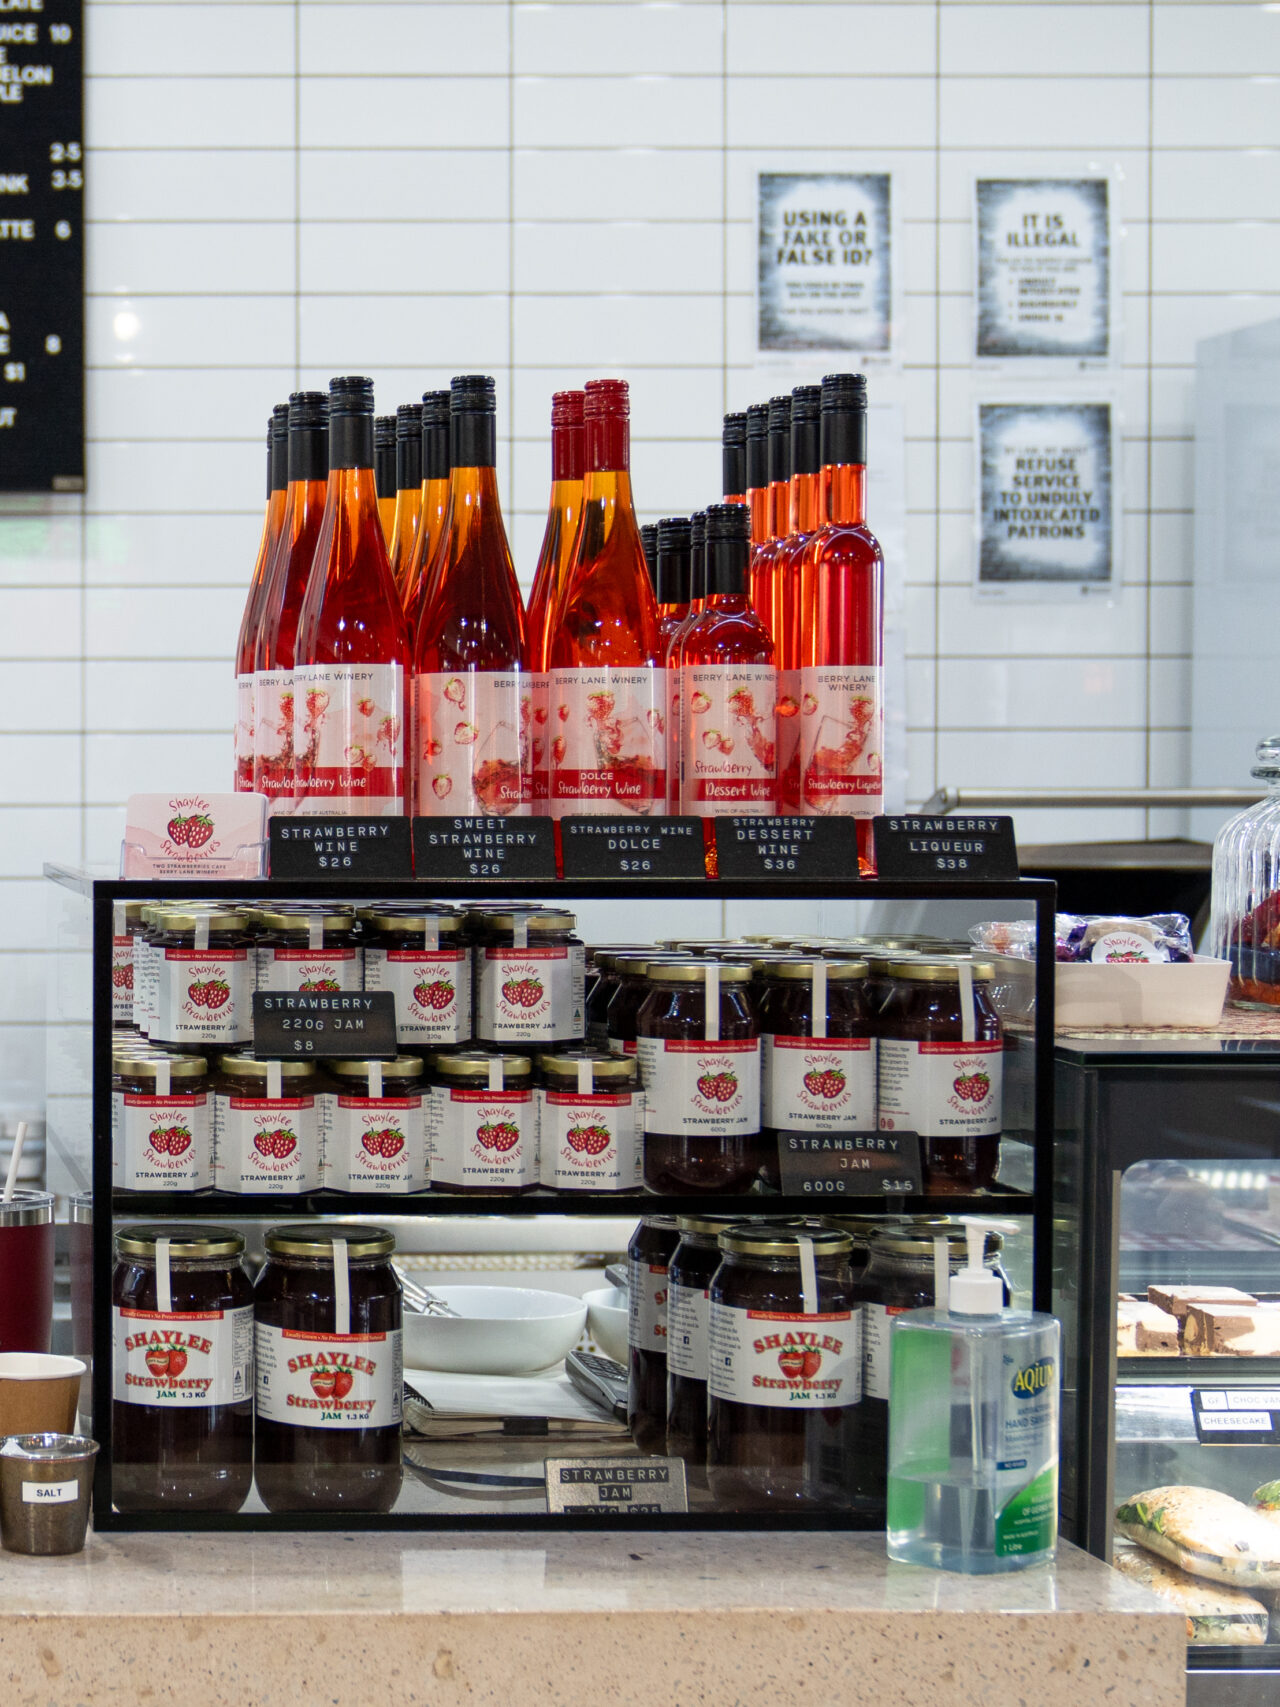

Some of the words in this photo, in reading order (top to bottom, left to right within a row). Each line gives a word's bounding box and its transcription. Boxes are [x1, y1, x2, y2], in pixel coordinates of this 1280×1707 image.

[49, 23, 71, 42] 10
[783, 211, 848, 226] USING
[854, 210, 867, 226] A
[1023, 214, 1039, 229] IT
[1046, 214, 1064, 229] IS
[783, 230, 834, 246] FAKE
[838, 230, 867, 246] OR
[1007, 232, 1080, 247] ILLEGAL
[776, 249, 836, 265] FALSE
[842, 249, 873, 265] ID?
[1015, 458, 1076, 472] REFUSE
[1012, 475, 1080, 488] SERVICE
[1000, 491, 1022, 506] TO
[1027, 491, 1093, 506] UNDULY
[993, 508, 1101, 522] INTOXICATED
[1007, 525, 1086, 539] PATRONS
[308, 673, 331, 682] LANE
[333, 672, 374, 681] WINERY
[581, 676, 607, 685] LANE
[610, 675, 648, 685] WINERY
[695, 760, 752, 776] Strawberry
[338, 774, 367, 788] Wine
[580, 772, 614, 781] DOLCE
[557, 780, 611, 798] Strawberry
[615, 782, 641, 795] Wine
[705, 782, 747, 797] Dessert
[807, 779, 855, 793] Strawberry
[168, 795, 211, 812] Shaylee
[454, 818, 507, 830] SWEET
[732, 817, 816, 828] STRAWBERRY
[889, 819, 999, 832] STRAWBERRY
[281, 824, 389, 839] STRAWBERRY
[570, 825, 650, 836] STRAWBERRY
[661, 826, 693, 836] WINE
[736, 829, 814, 841] DESSERT
[429, 833, 537, 845] STRAWBERRY
[608, 839, 661, 851] DOLCE
[314, 840, 358, 852] WINE
[758, 844, 800, 856] WINE
[909, 840, 985, 853] LIQUEUR
[462, 847, 506, 860] WINE
[318, 855, 353, 868] $26
[619, 859, 652, 871] $26
[763, 858, 797, 871] $36
[936, 857, 969, 870] $38
[469, 862, 501, 875] $26
[188, 963, 226, 978] Shaylee
[264, 998, 372, 1009] STRAWBERRY
[181, 1000, 236, 1023] Strawberries
[281, 1017, 325, 1030] 220G
[333, 1018, 364, 1030] JAM
[201, 1032, 217, 1040] 220g
[293, 1039, 314, 1051] $8
[697, 1055, 734, 1070] Shaylee
[690, 1093, 744, 1116] Strawberries
[682, 1117, 734, 1125] STRAWBERRY
[840, 1157, 870, 1169] JAM
[803, 1181, 846, 1192] 600G
[882, 1179, 913, 1191] $15
[125, 1330, 213, 1355] SHAYLEE
[753, 1331, 844, 1355] SHAYLEE
[287, 1351, 377, 1376] SHAYLEE
[125, 1371, 213, 1391] Strawberry
[752, 1374, 843, 1392] Strawberry
[156, 1390, 177, 1399] JAM
[286, 1393, 376, 1413] Strawberry
[1204, 1416, 1268, 1426] CHEESECAKE
[561, 1469, 668, 1481] STRAWBERRY
[36, 1487, 63, 1498] SALT
[600, 1486, 631, 1499] JAM
